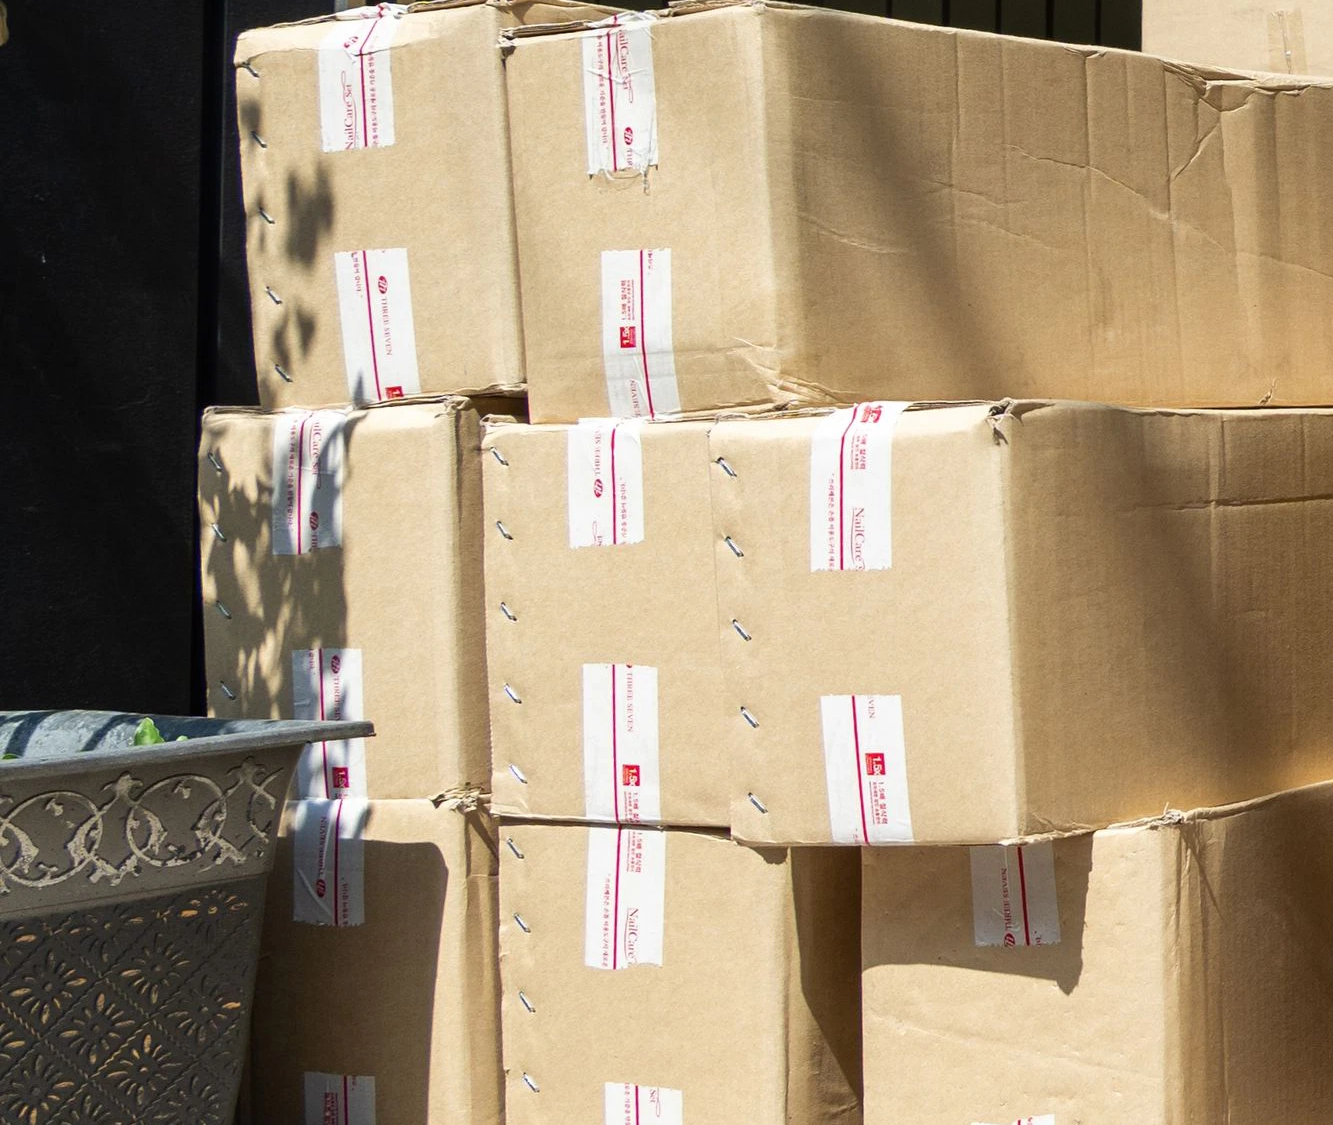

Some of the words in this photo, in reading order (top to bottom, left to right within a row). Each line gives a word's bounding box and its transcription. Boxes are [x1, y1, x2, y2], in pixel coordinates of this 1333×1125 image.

[616, 29, 631, 72] ailCare
[343, 101, 356, 151] NailCare
[380, 296, 391, 326] THREE
[383, 327, 393, 356] SEVEN
[629, 379, 640, 410] SEVEN
[853, 506, 866, 563] NailCare
[626, 672, 636, 701] THREE
[626, 703, 636, 733] SEVEN
[1000, 868, 1010, 899] SEVEN
[1002, 901, 1013, 930] THREE
[627, 908, 641, 959] NailCare
